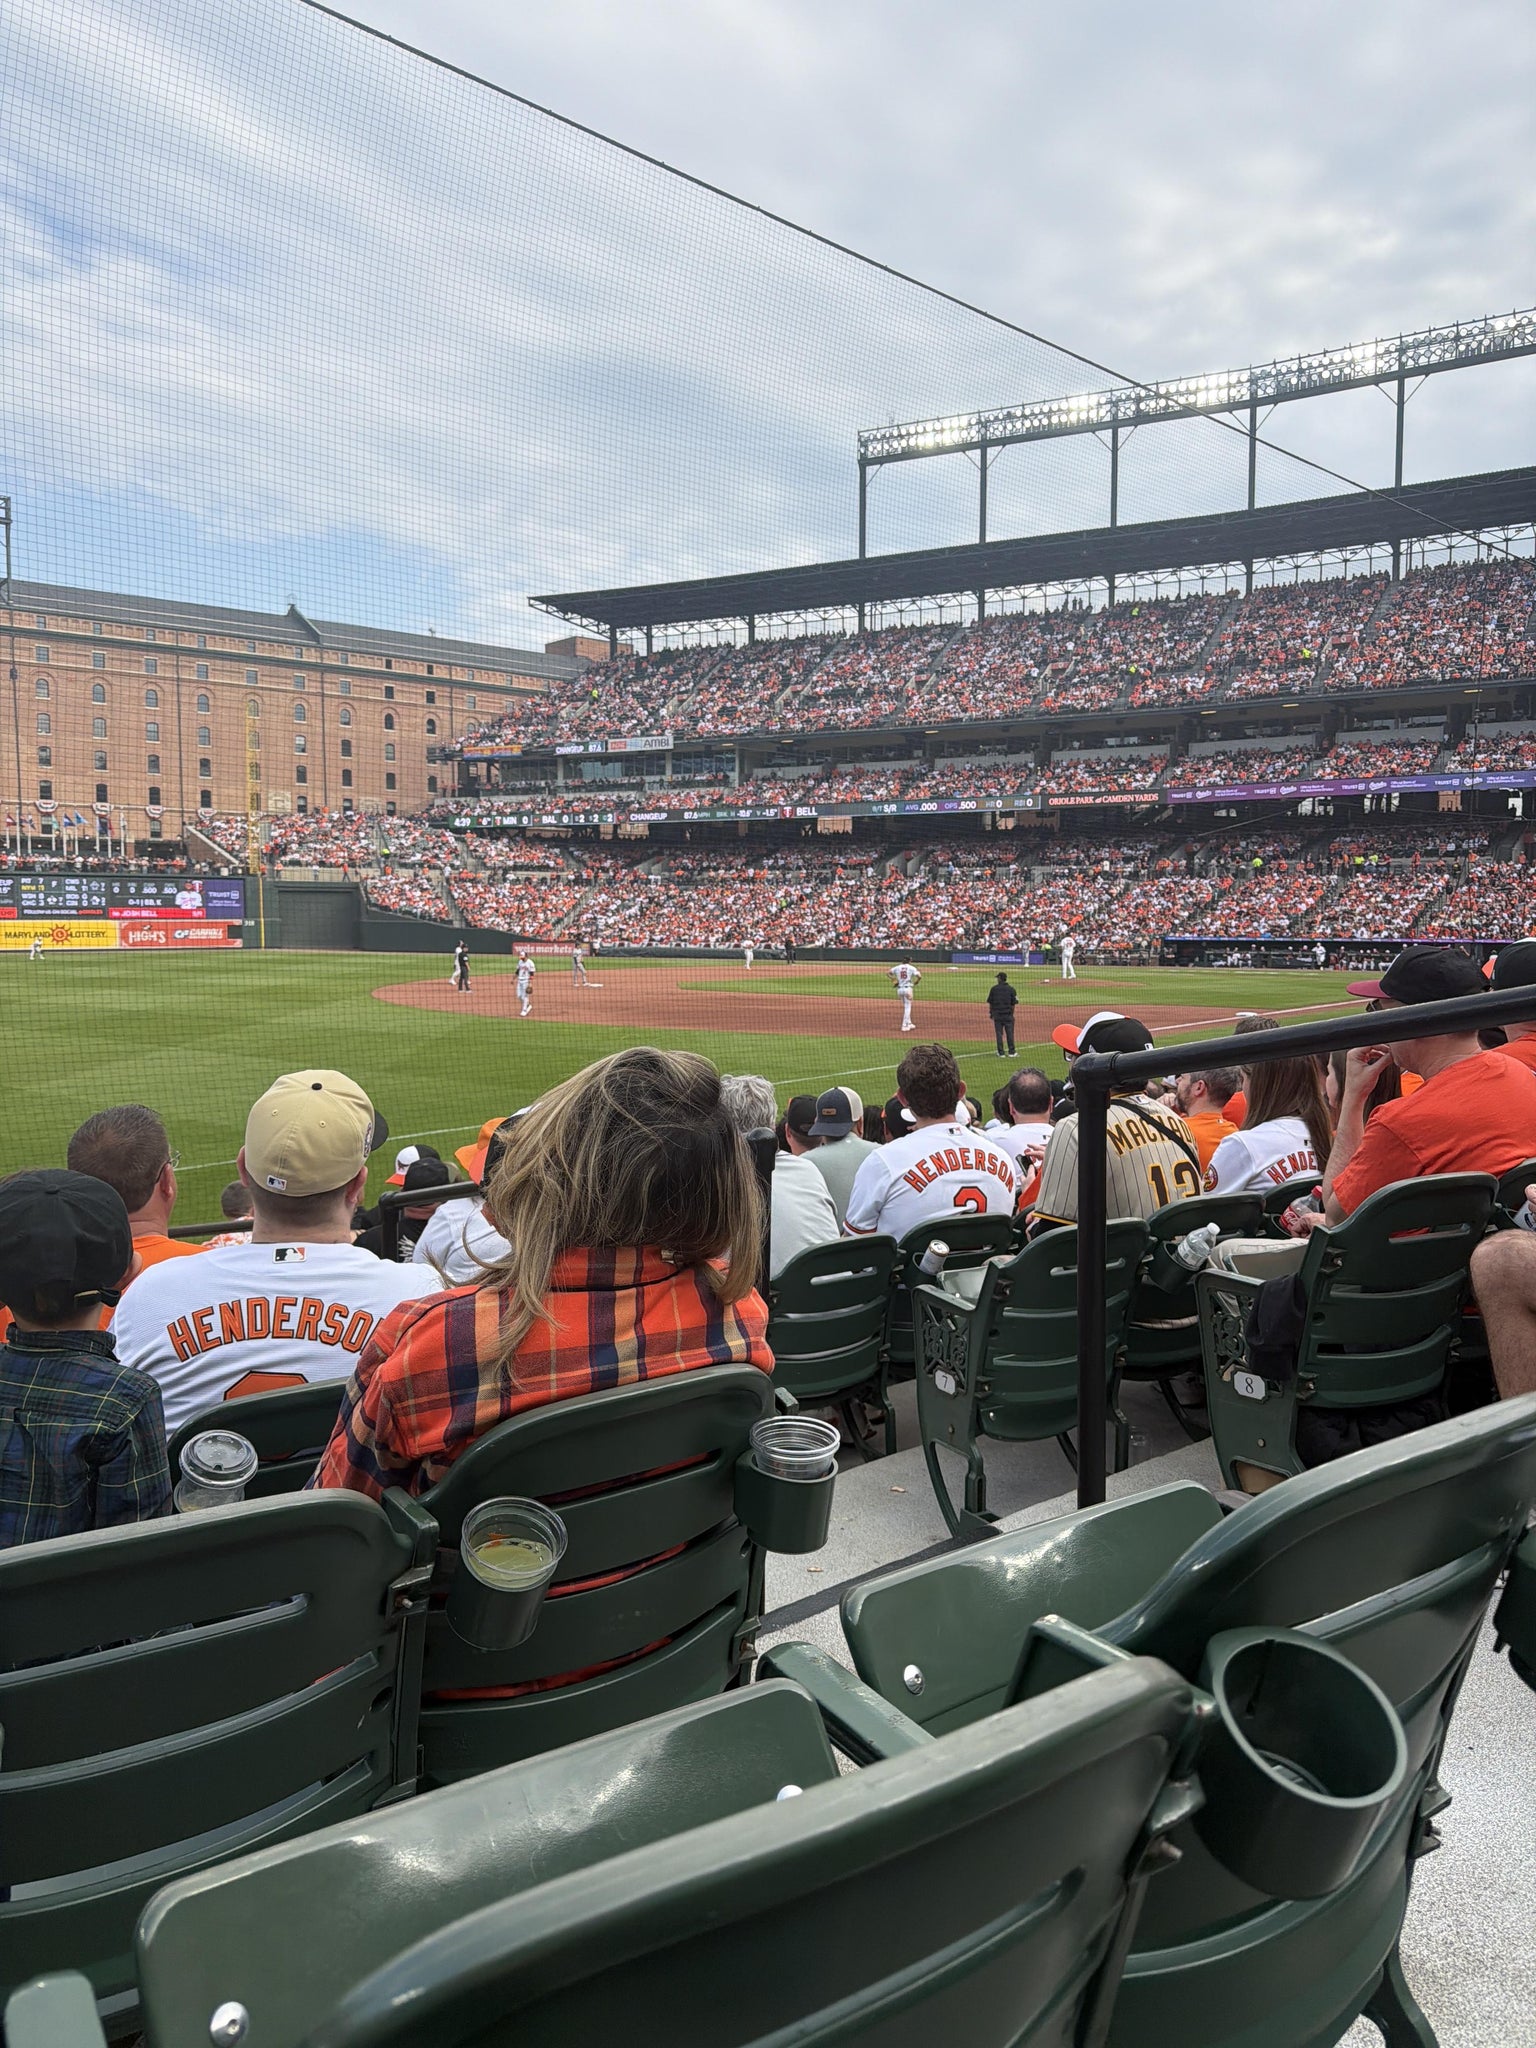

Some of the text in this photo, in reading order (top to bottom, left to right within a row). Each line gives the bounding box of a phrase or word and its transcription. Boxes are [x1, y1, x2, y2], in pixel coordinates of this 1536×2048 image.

[643, 738, 670, 748] AMBI
[1049, 797, 1076, 806] ORIOLE
[1076, 796, 1094, 804] PARK
[1102, 795, 1133, 803] CAMDEN
[1134, 793, 1159, 802] YARDS
[920, 802, 937, 811] .000
[958, 801, 976, 809] .500
[797, 807, 817, 816] BELL
[503, 816, 528, 824] MIN 0
[542, 815, 569, 824] BAL 0
[579, 814, 585, 822] 2
[593, 814, 599, 822] 2
[5, 931, 106, 939] MARYLAND LOTTERY
[129, 931, 166, 943] HIGH'S
[515, 944, 573, 953] weis markets
[903, 1148, 1014, 1194] HENDERSON
[942, 1374, 948, 1389] 7
[1245, 1377, 1253, 1394] 8
